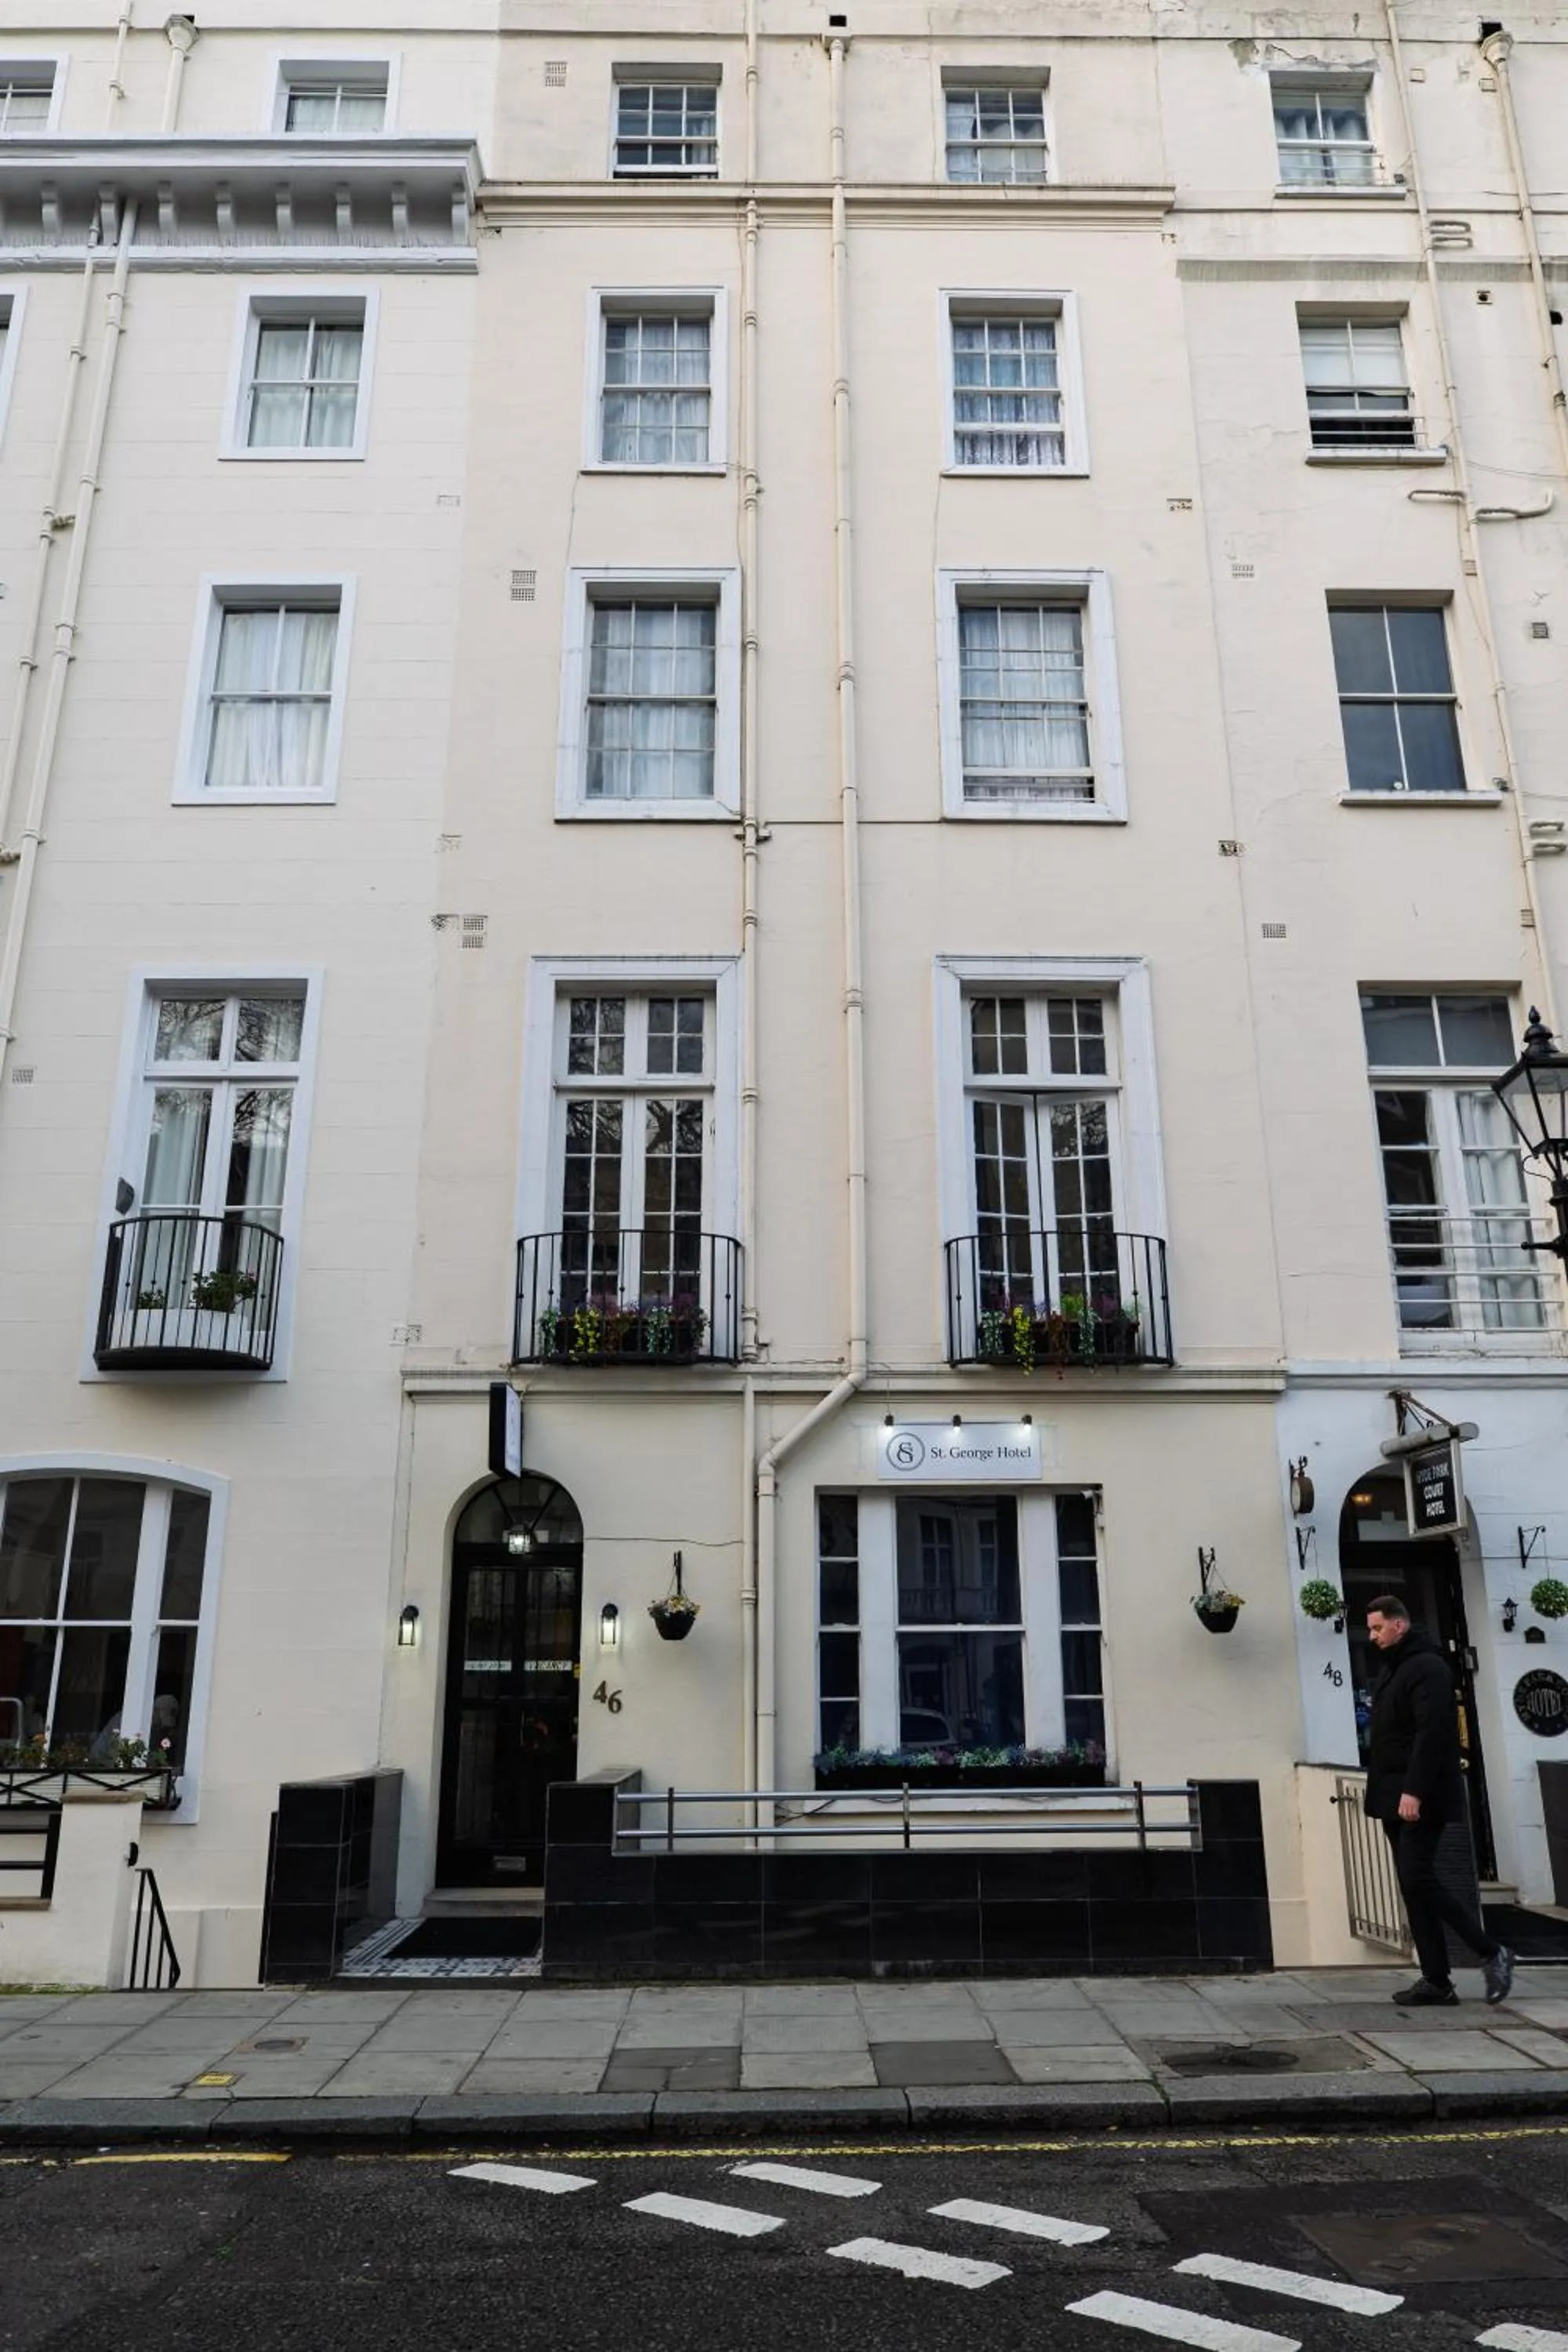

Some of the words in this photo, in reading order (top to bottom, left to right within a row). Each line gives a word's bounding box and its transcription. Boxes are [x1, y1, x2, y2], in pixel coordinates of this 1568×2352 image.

[931, 1446, 946, 1459] St.
[949, 1446, 993, 1462] George
[997, 1446, 1032, 1459] Hotel
[1426, 1501, 1445, 1517] HOTEL
[1323, 1661, 1343, 1687] 48
[593, 1680, 622, 1715] 46
[1526, 1687, 1562, 1719] HOTEL
